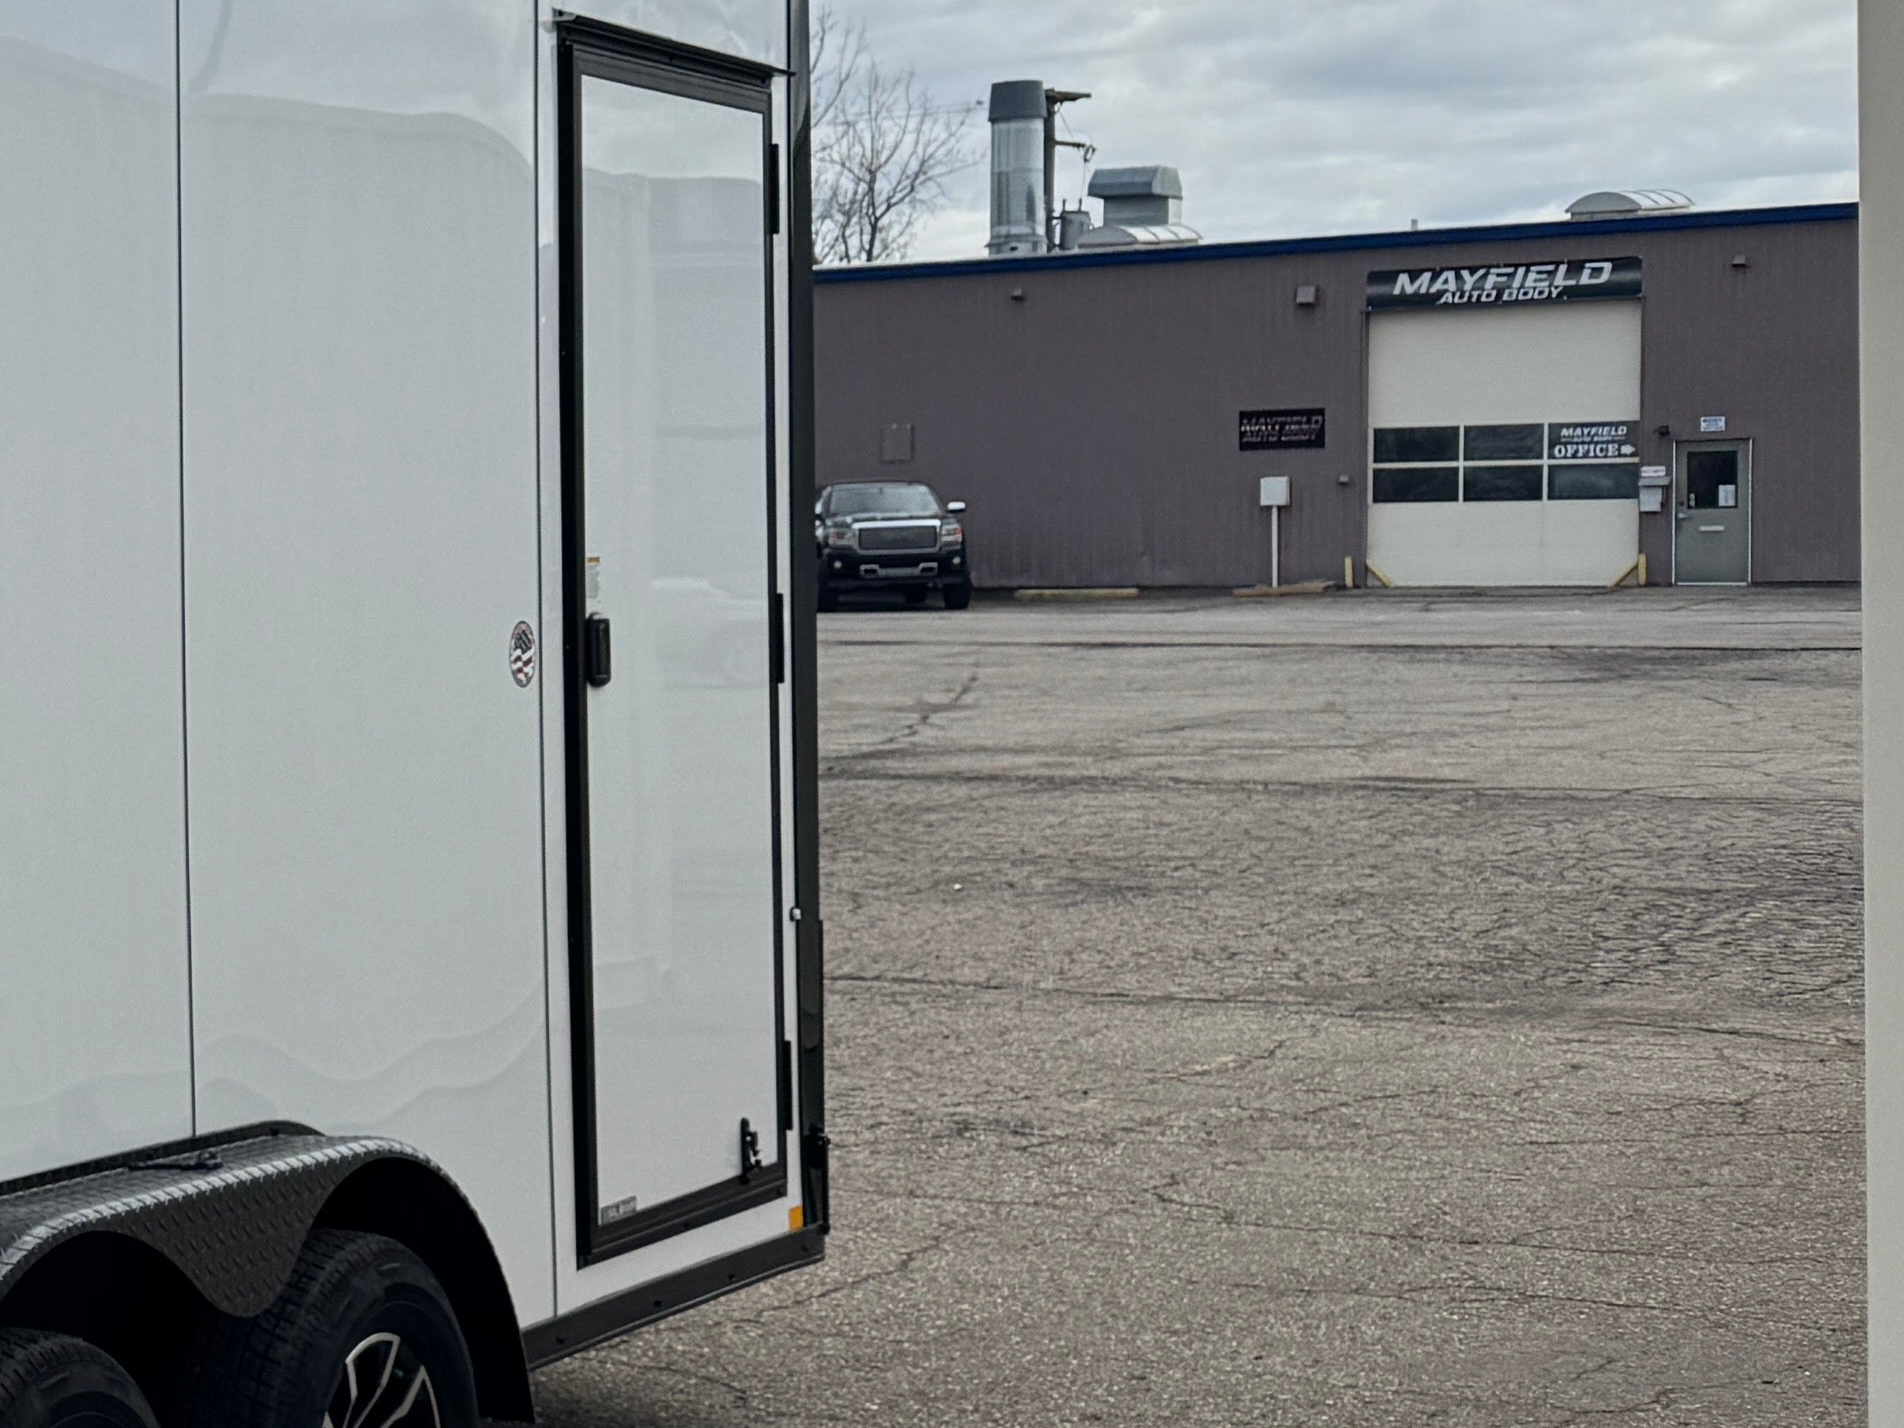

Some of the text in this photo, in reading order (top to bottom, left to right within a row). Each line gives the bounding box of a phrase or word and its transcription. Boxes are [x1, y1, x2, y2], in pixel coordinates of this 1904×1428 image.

[1393, 262, 1613, 295] MAYFIELD
[1438, 286, 1563, 305] AUTO BODY
[1560, 425, 1628, 437] MAYFIELD
[1554, 443, 1619, 458] OFFICE
